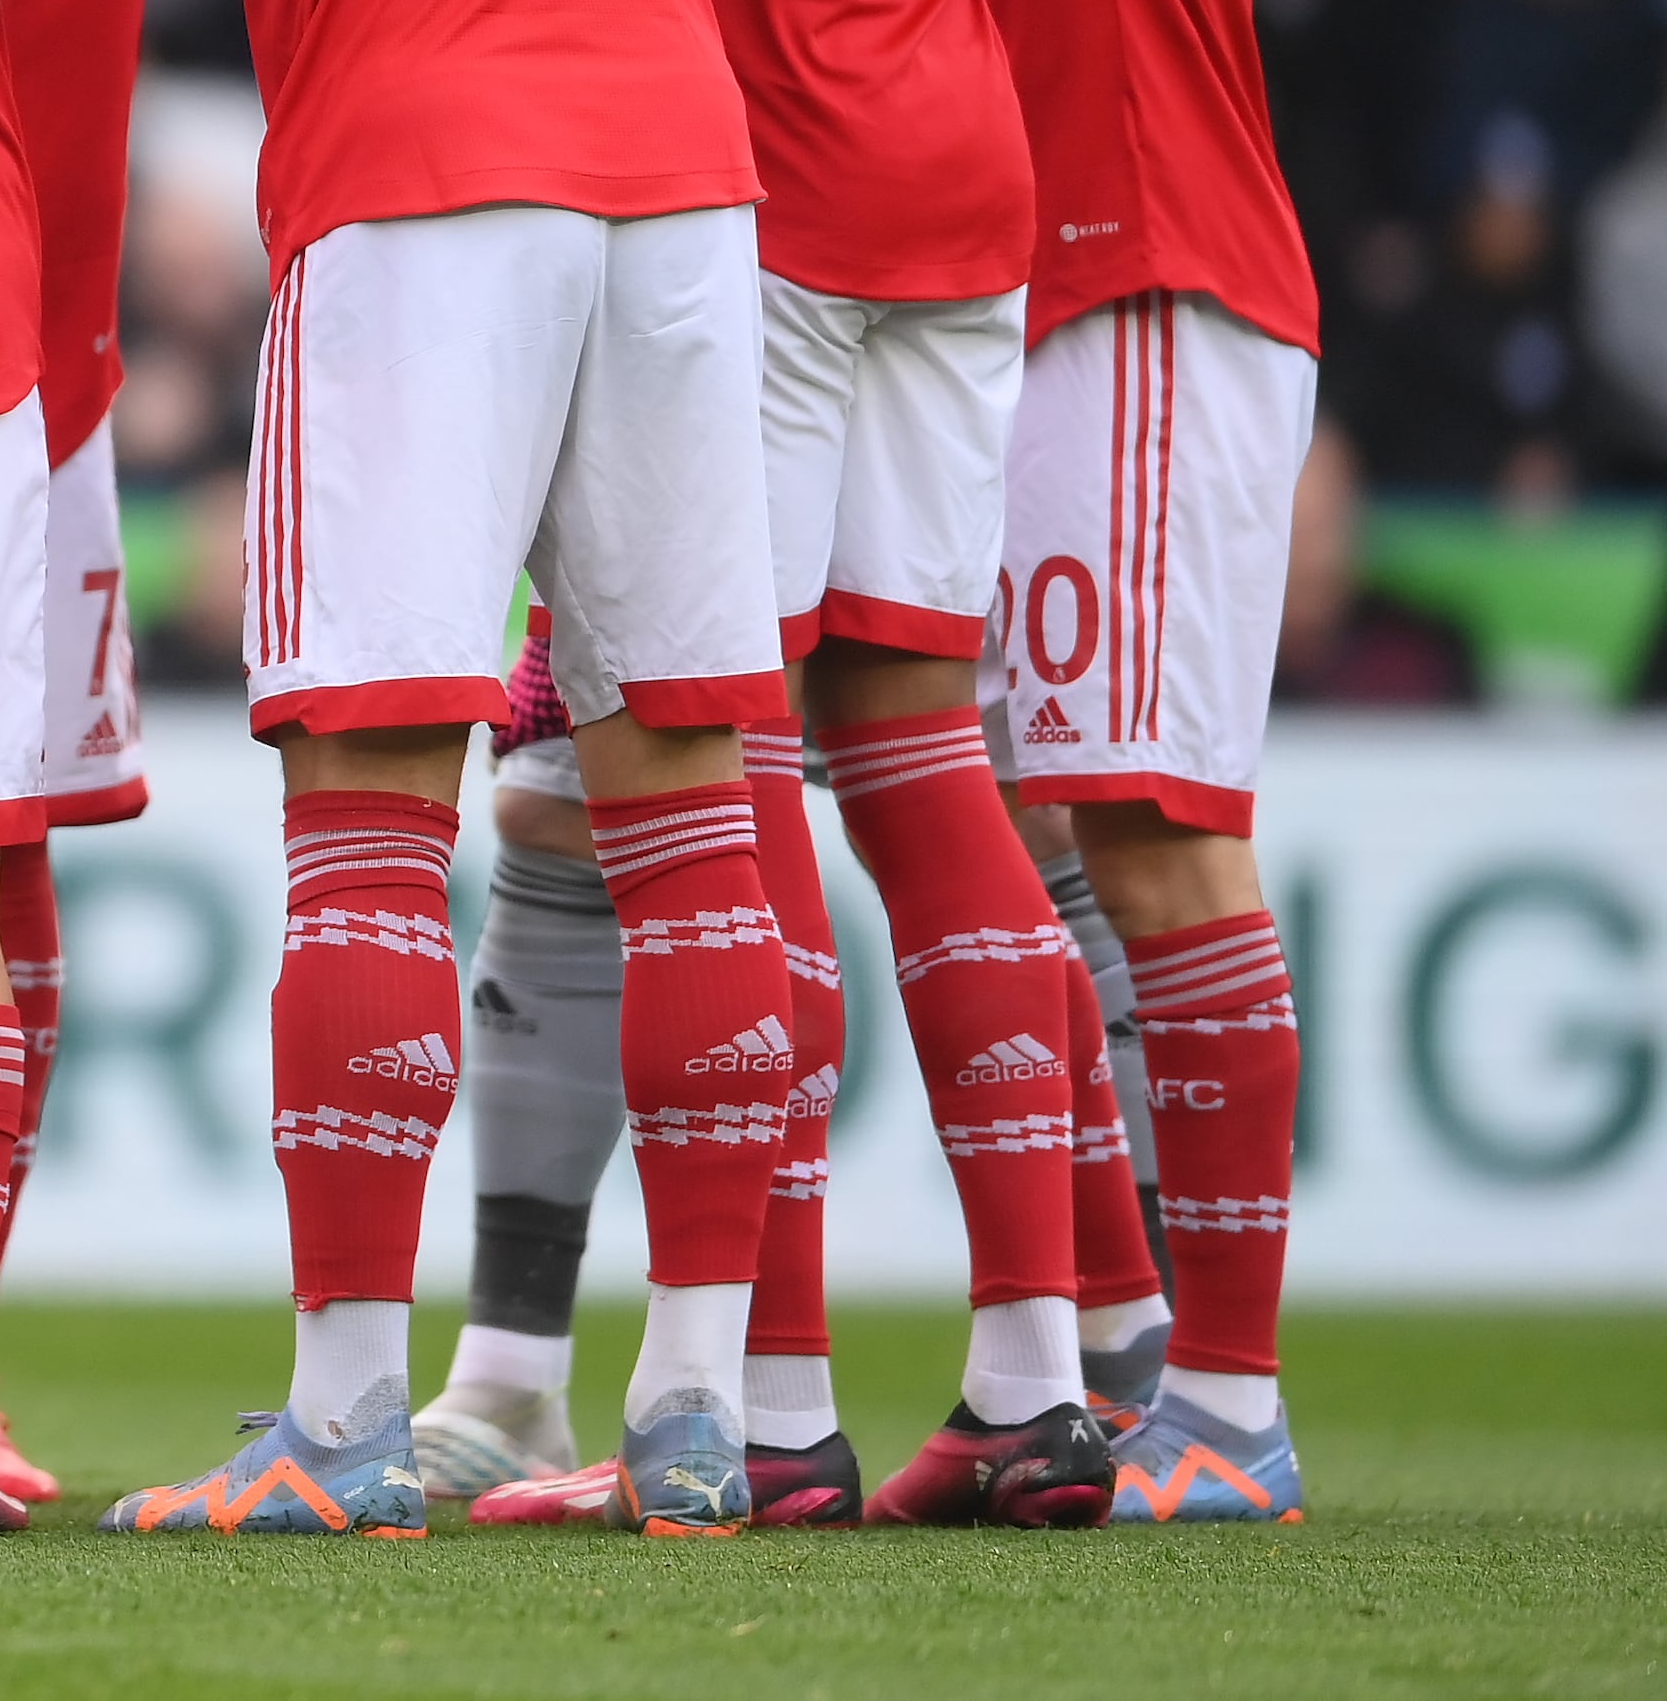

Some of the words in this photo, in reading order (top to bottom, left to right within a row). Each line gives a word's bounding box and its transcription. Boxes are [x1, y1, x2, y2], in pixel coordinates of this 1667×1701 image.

[83, 569, 120, 697] 7
[346, 1055, 459, 1095] adidas
[684, 1051, 796, 1076] adidas
[955, 1059, 1067, 1087] adidas
